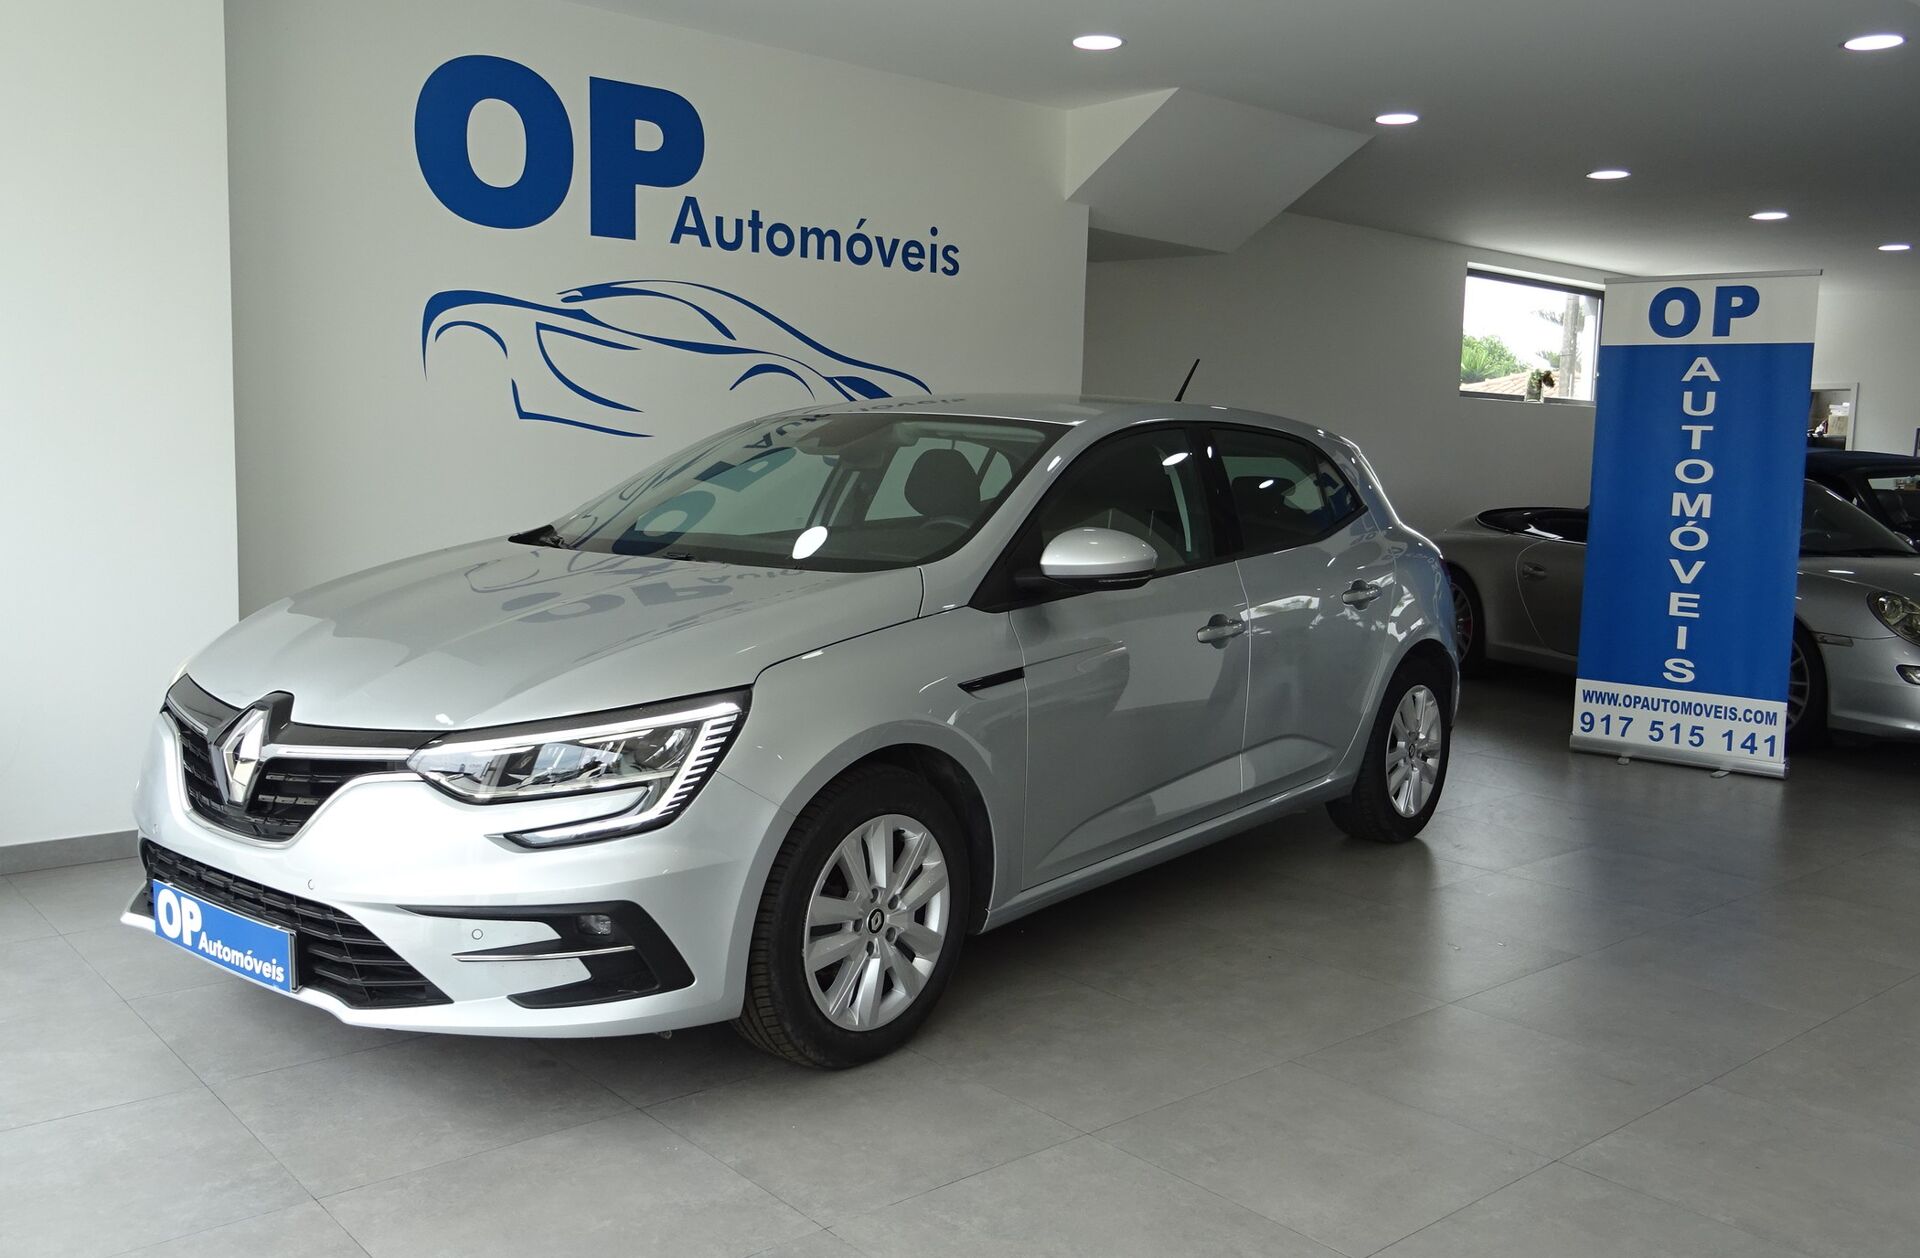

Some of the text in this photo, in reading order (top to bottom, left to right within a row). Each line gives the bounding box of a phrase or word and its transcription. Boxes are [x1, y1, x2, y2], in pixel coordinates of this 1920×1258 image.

[414, 55, 961, 277] OP Automóveis
[1648, 285, 1760, 338] OP
[1662, 356, 1721, 684] AUTOMÓVEIS
[1580, 711, 1777, 758] 917 515 141
[1582, 688, 1778, 725] WWW.OPAUTOMOVEIS.COM
[157, 888, 285, 983] OP Automóveis
